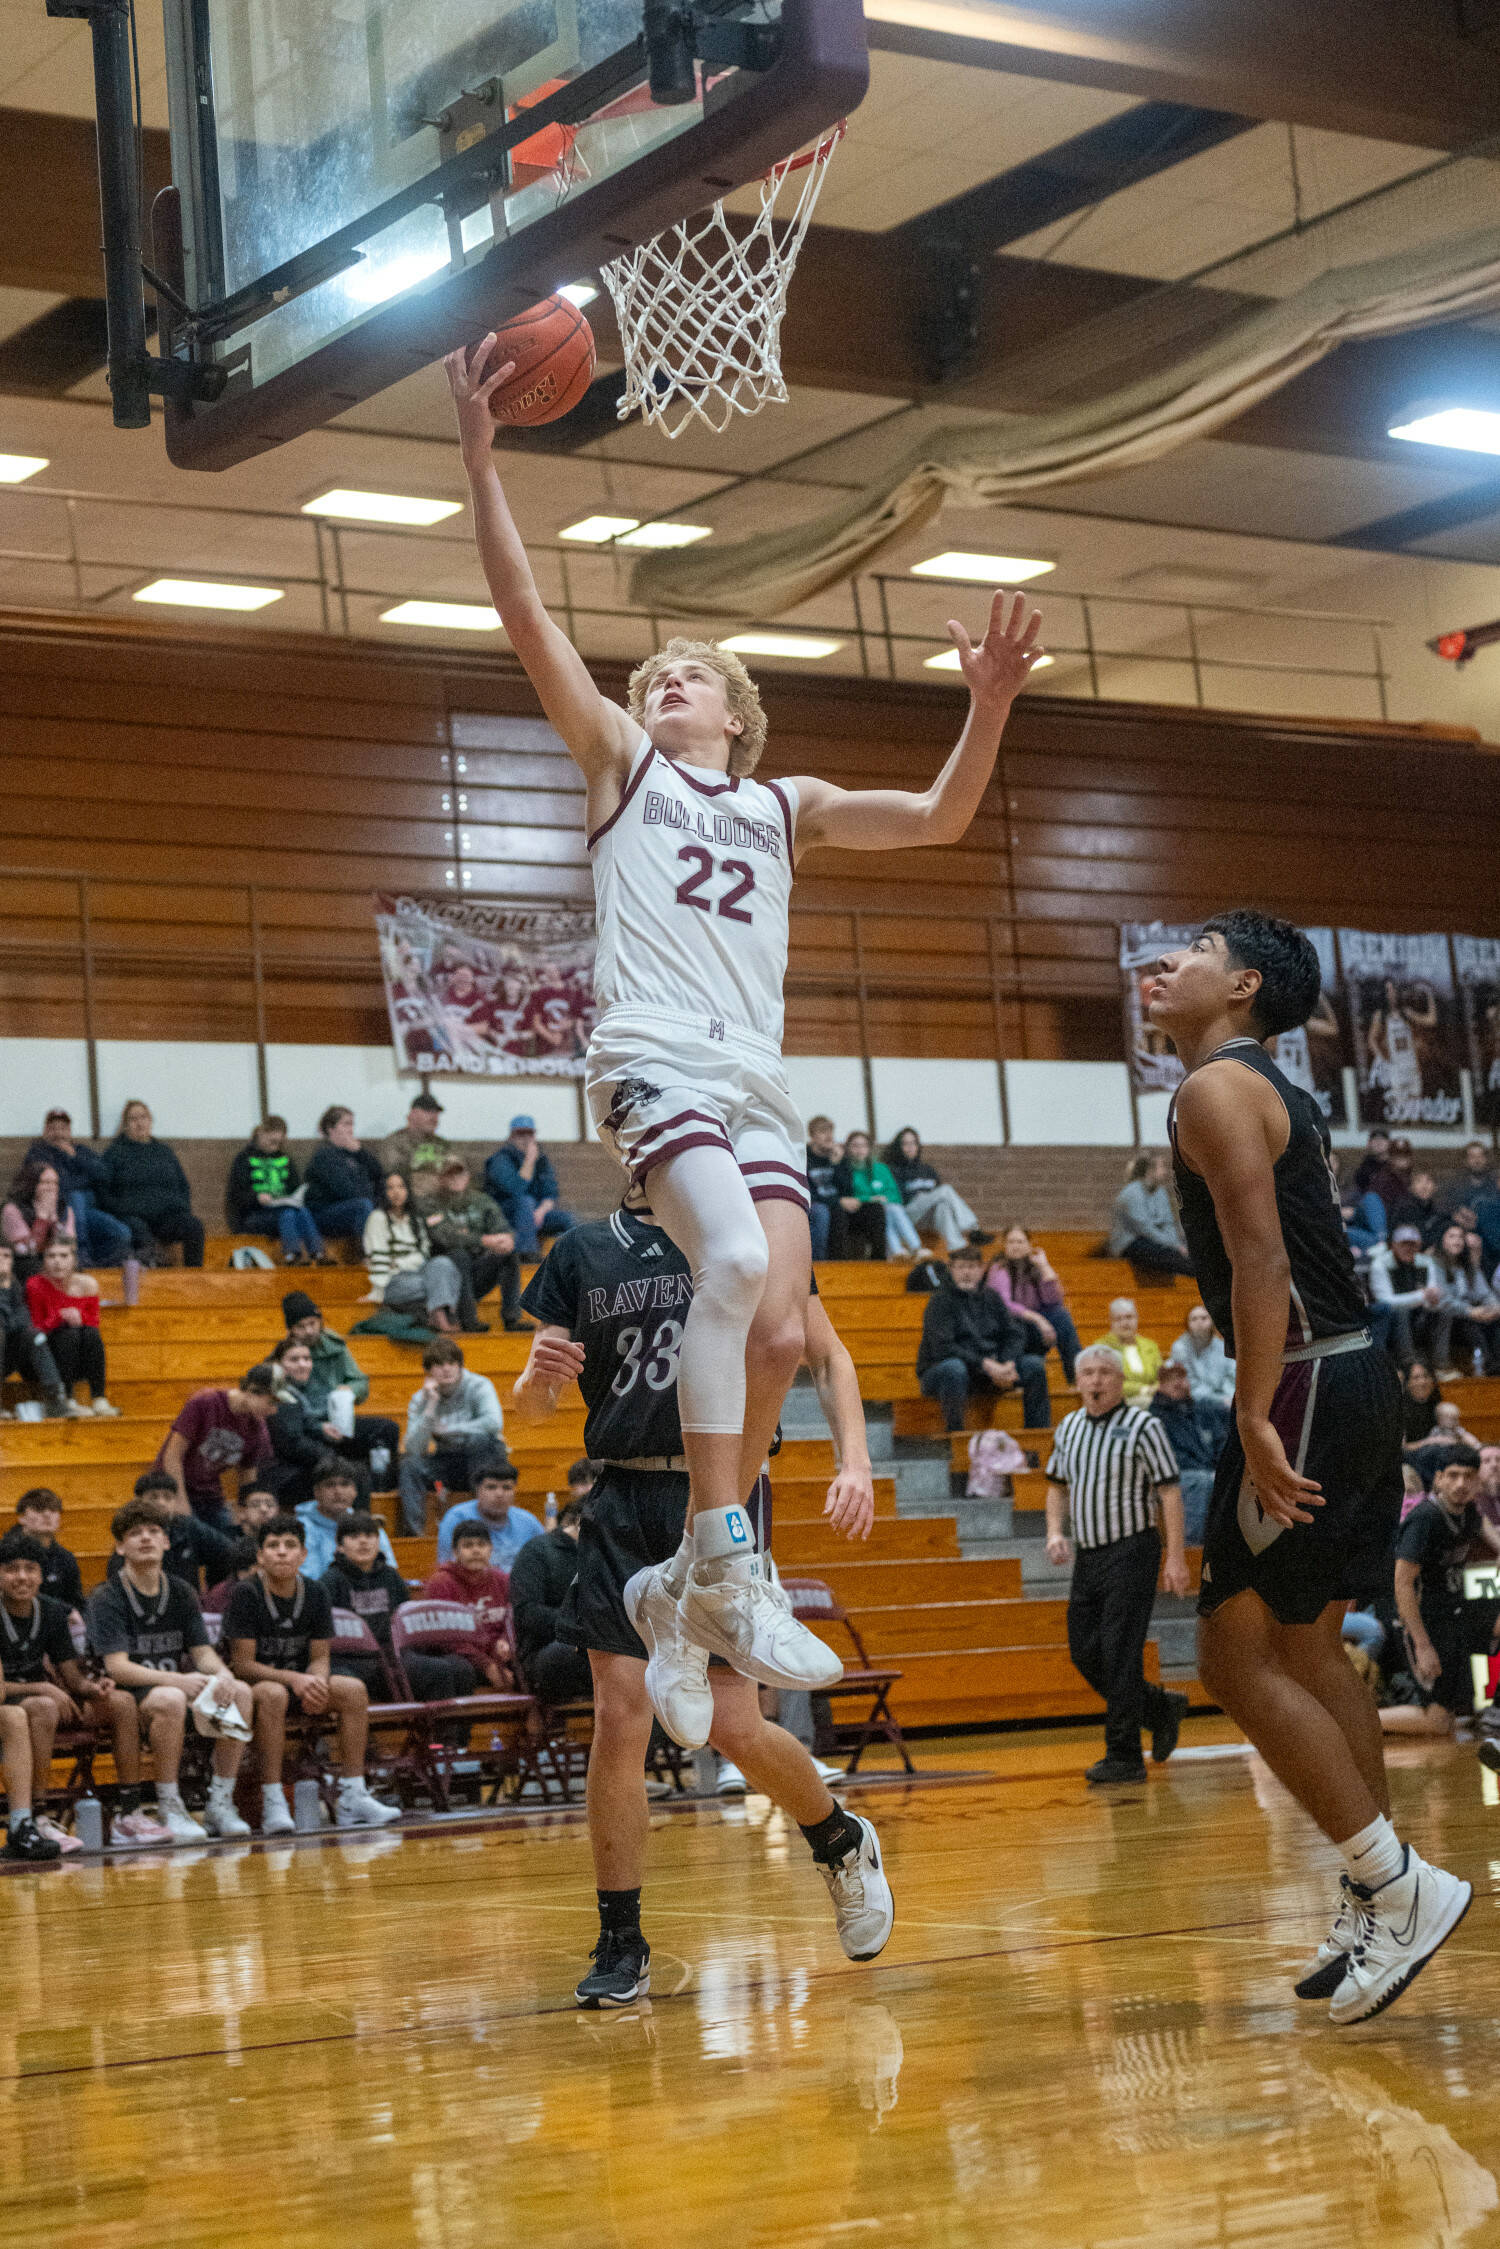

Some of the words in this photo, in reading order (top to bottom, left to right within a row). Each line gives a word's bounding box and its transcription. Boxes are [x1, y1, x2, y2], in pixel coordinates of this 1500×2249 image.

[642, 790, 781, 860] BULLDOGS
[676, 845, 756, 926] 22
[415, 1052, 484, 1074] BAND
[708, 1017, 726, 1042] M
[611, 1319, 685, 1398] 33
